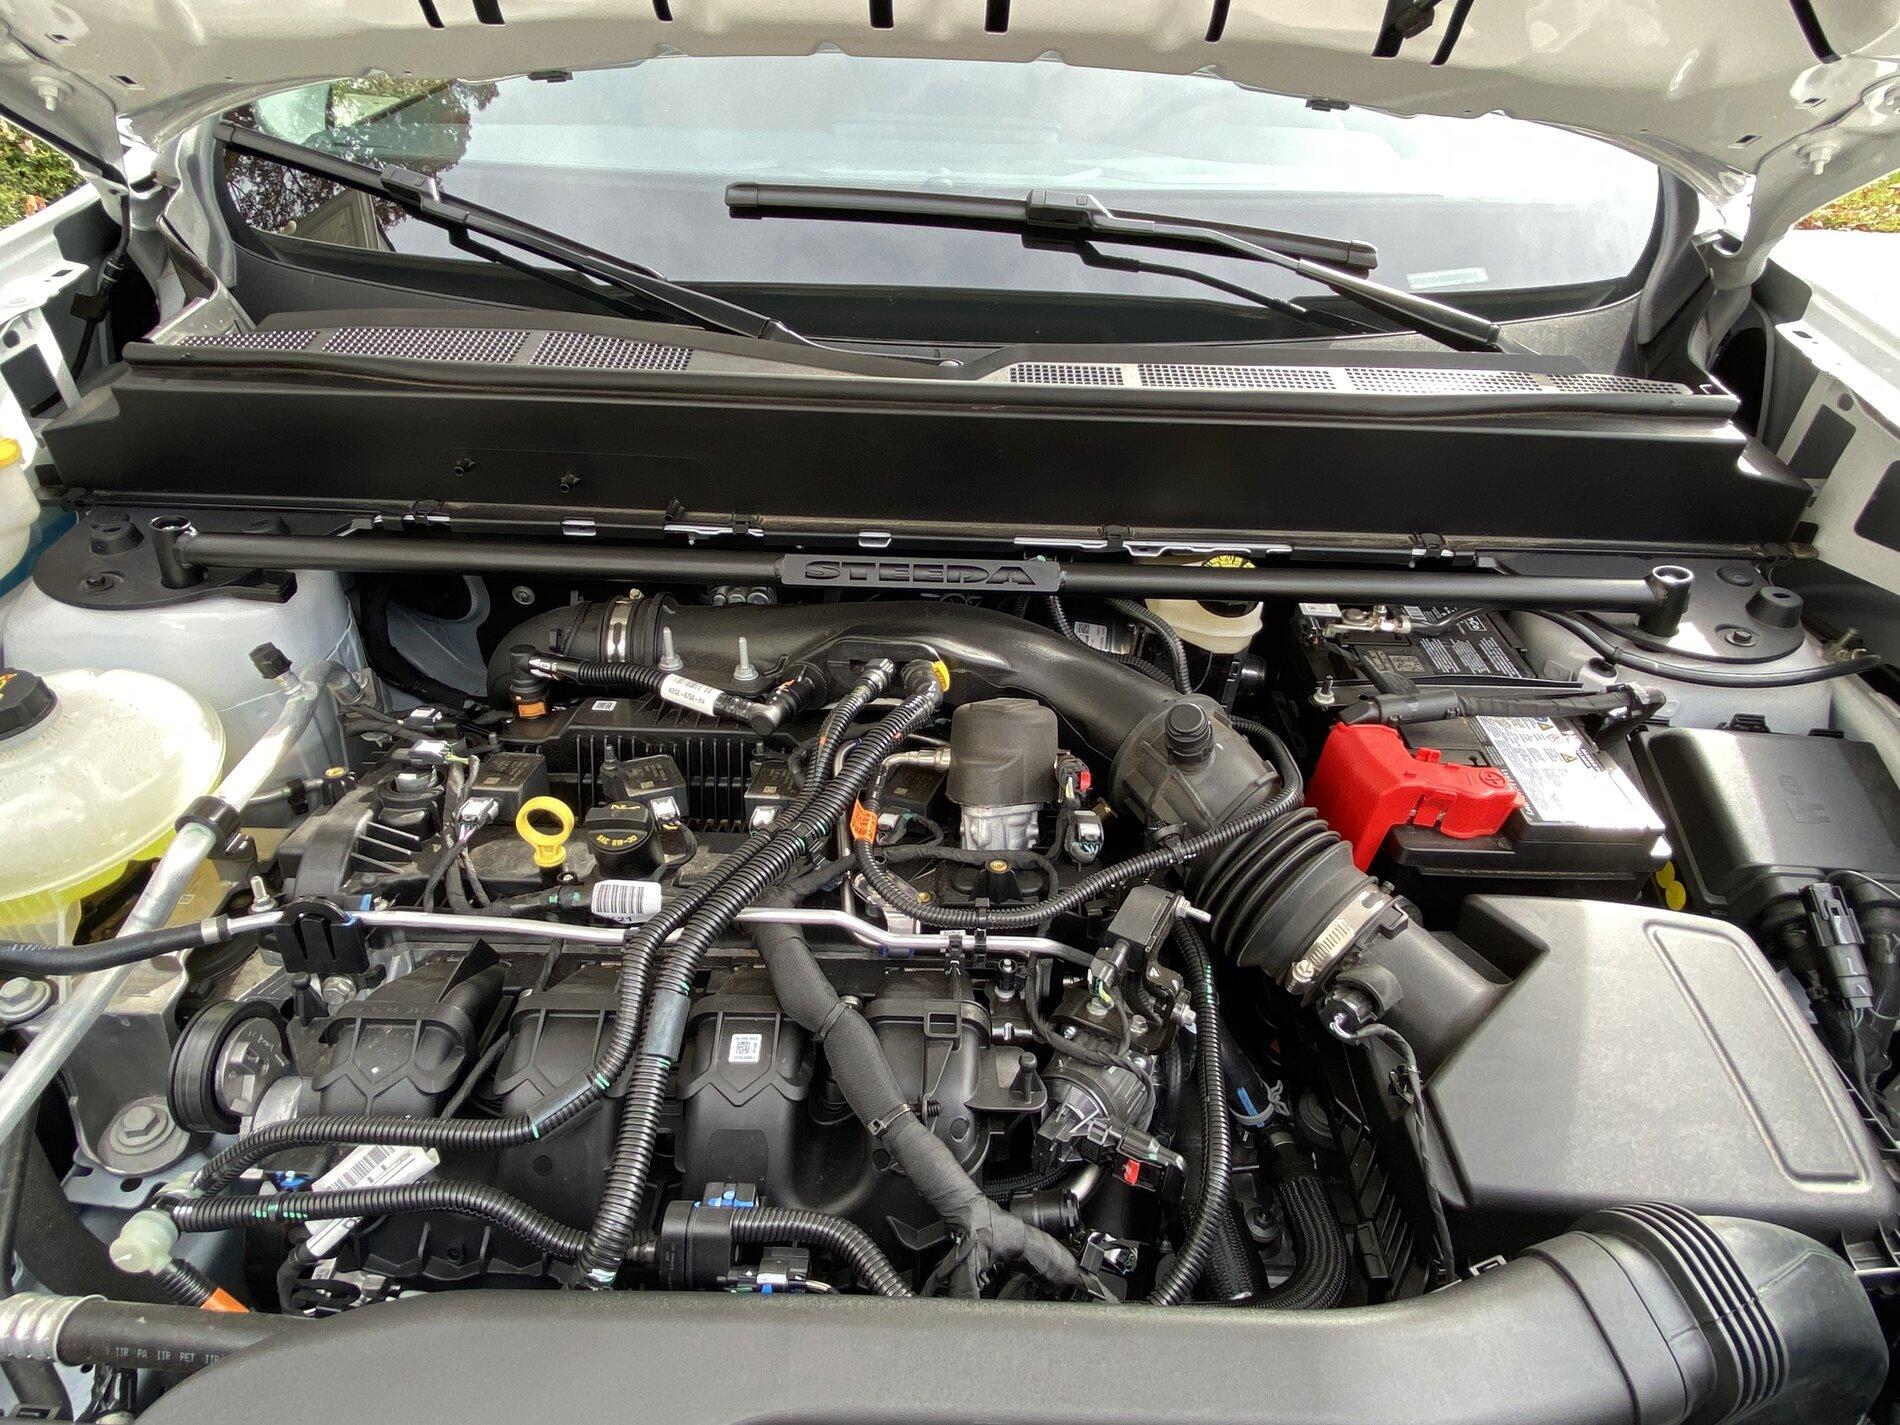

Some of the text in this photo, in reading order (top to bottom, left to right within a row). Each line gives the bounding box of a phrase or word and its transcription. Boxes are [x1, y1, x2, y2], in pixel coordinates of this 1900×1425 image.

[804, 560, 1036, 586] STEEDA
[137, 1348, 148, 1359] PA
[179, 1352, 195, 1363] PET
